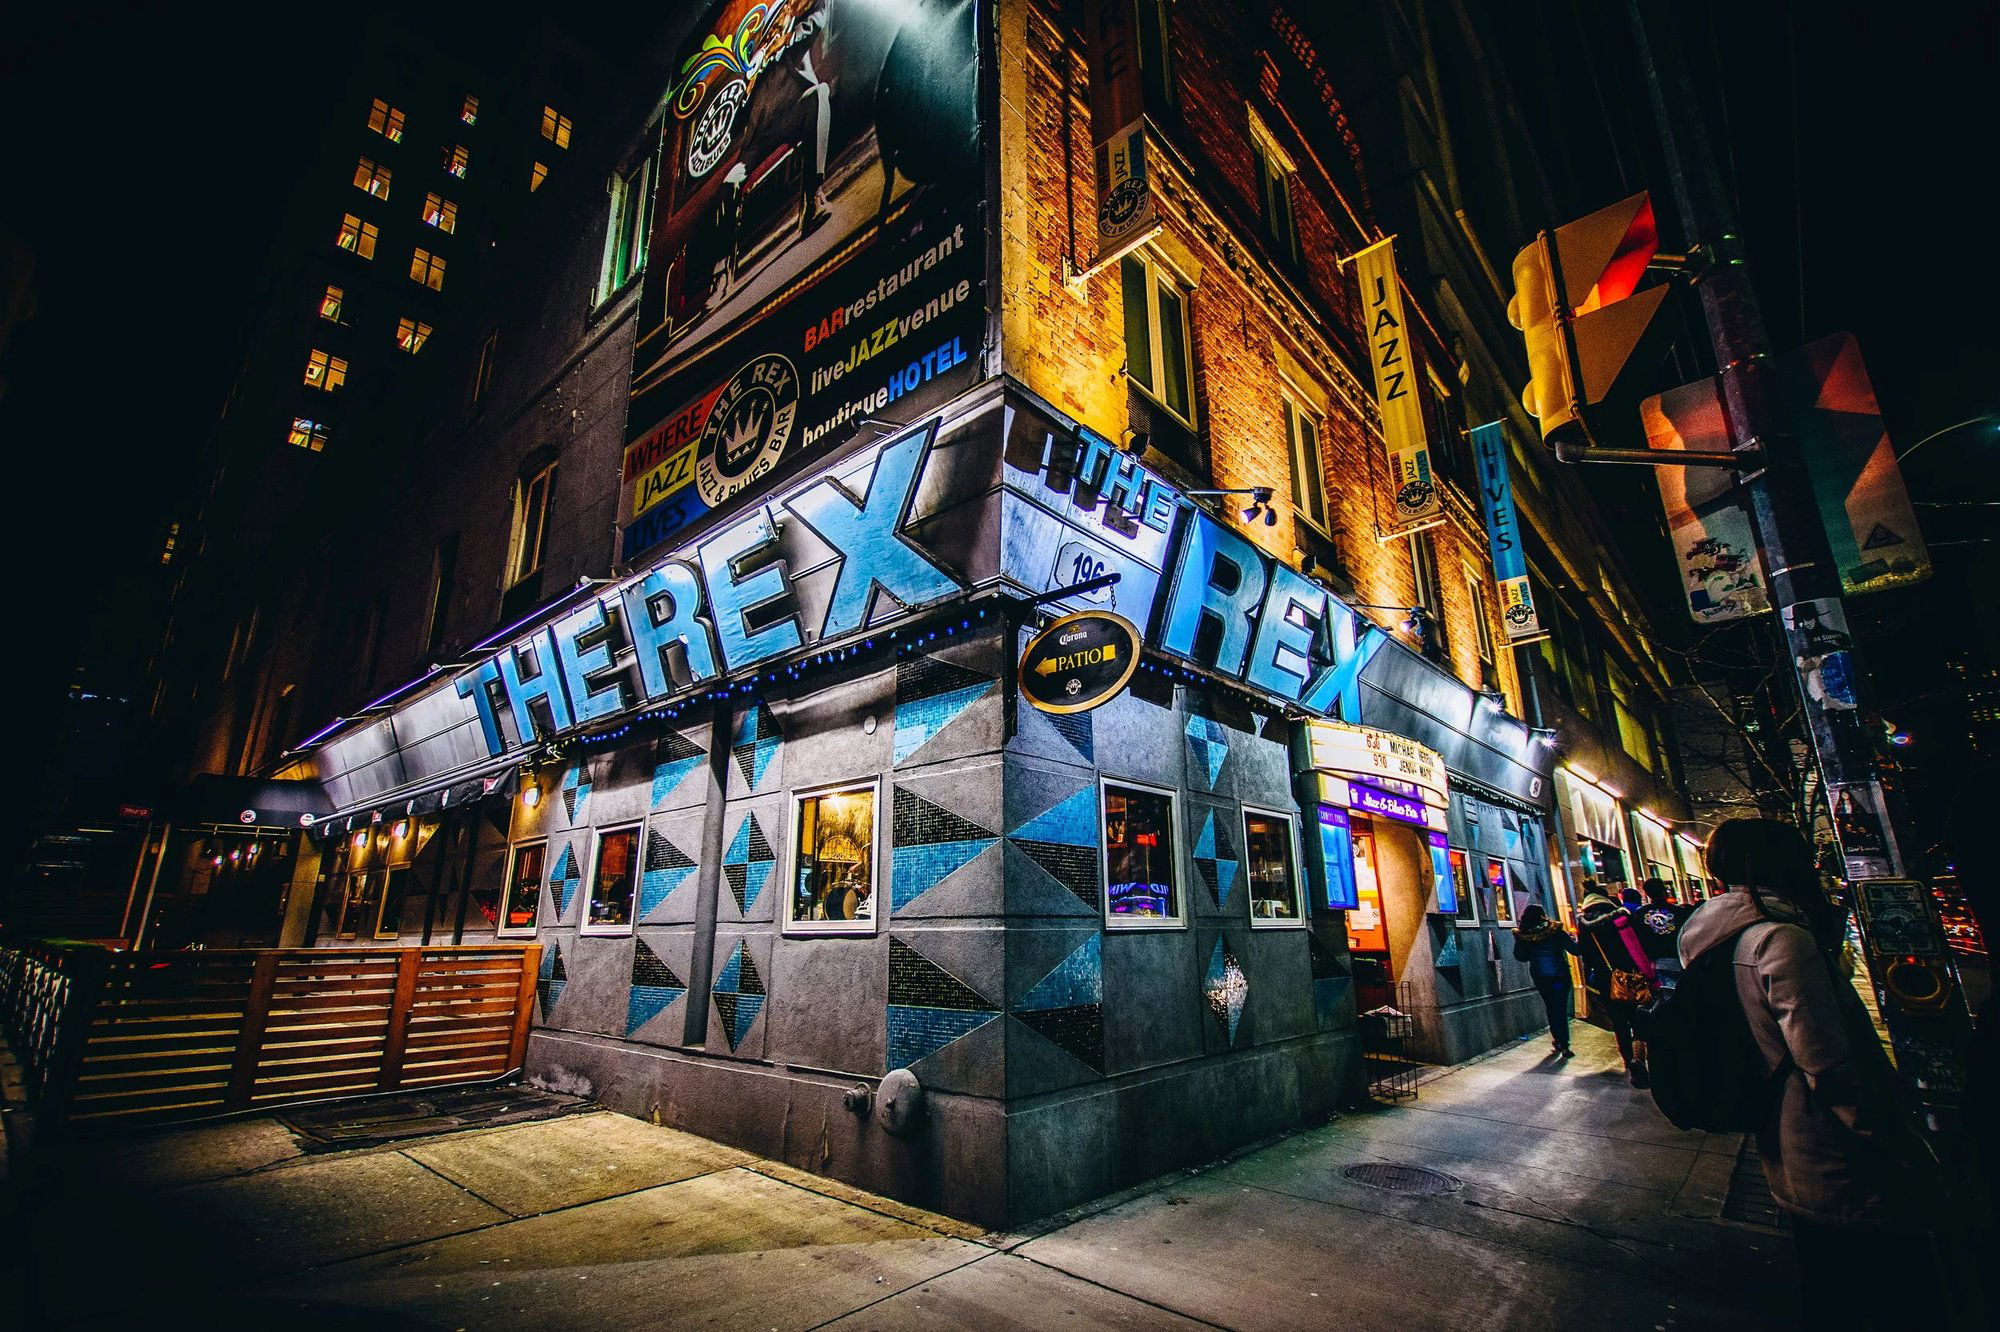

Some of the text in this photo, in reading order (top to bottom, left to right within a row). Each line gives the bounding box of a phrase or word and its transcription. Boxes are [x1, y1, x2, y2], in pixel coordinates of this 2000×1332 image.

[1114, 147, 1128, 181] JAZZ
[1372, 275, 1408, 401] JAZZ
[703, 361, 791, 440] THE REX
[630, 402, 704, 474] WHERE
[699, 409, 792, 503] JAZZ & BLUES BAR
[1404, 460, 1418, 480] JAZZ
[637, 448, 692, 513] JAZZ
[1415, 481, 1431, 491] REX
[1481, 440, 1513, 552] LIVES
[454, 416, 970, 757] THE REX
[1076, 424, 1392, 723] THE REX
[1058, 648, 1102, 672] PATIO
[1059, 631, 1088, 646] Corona
